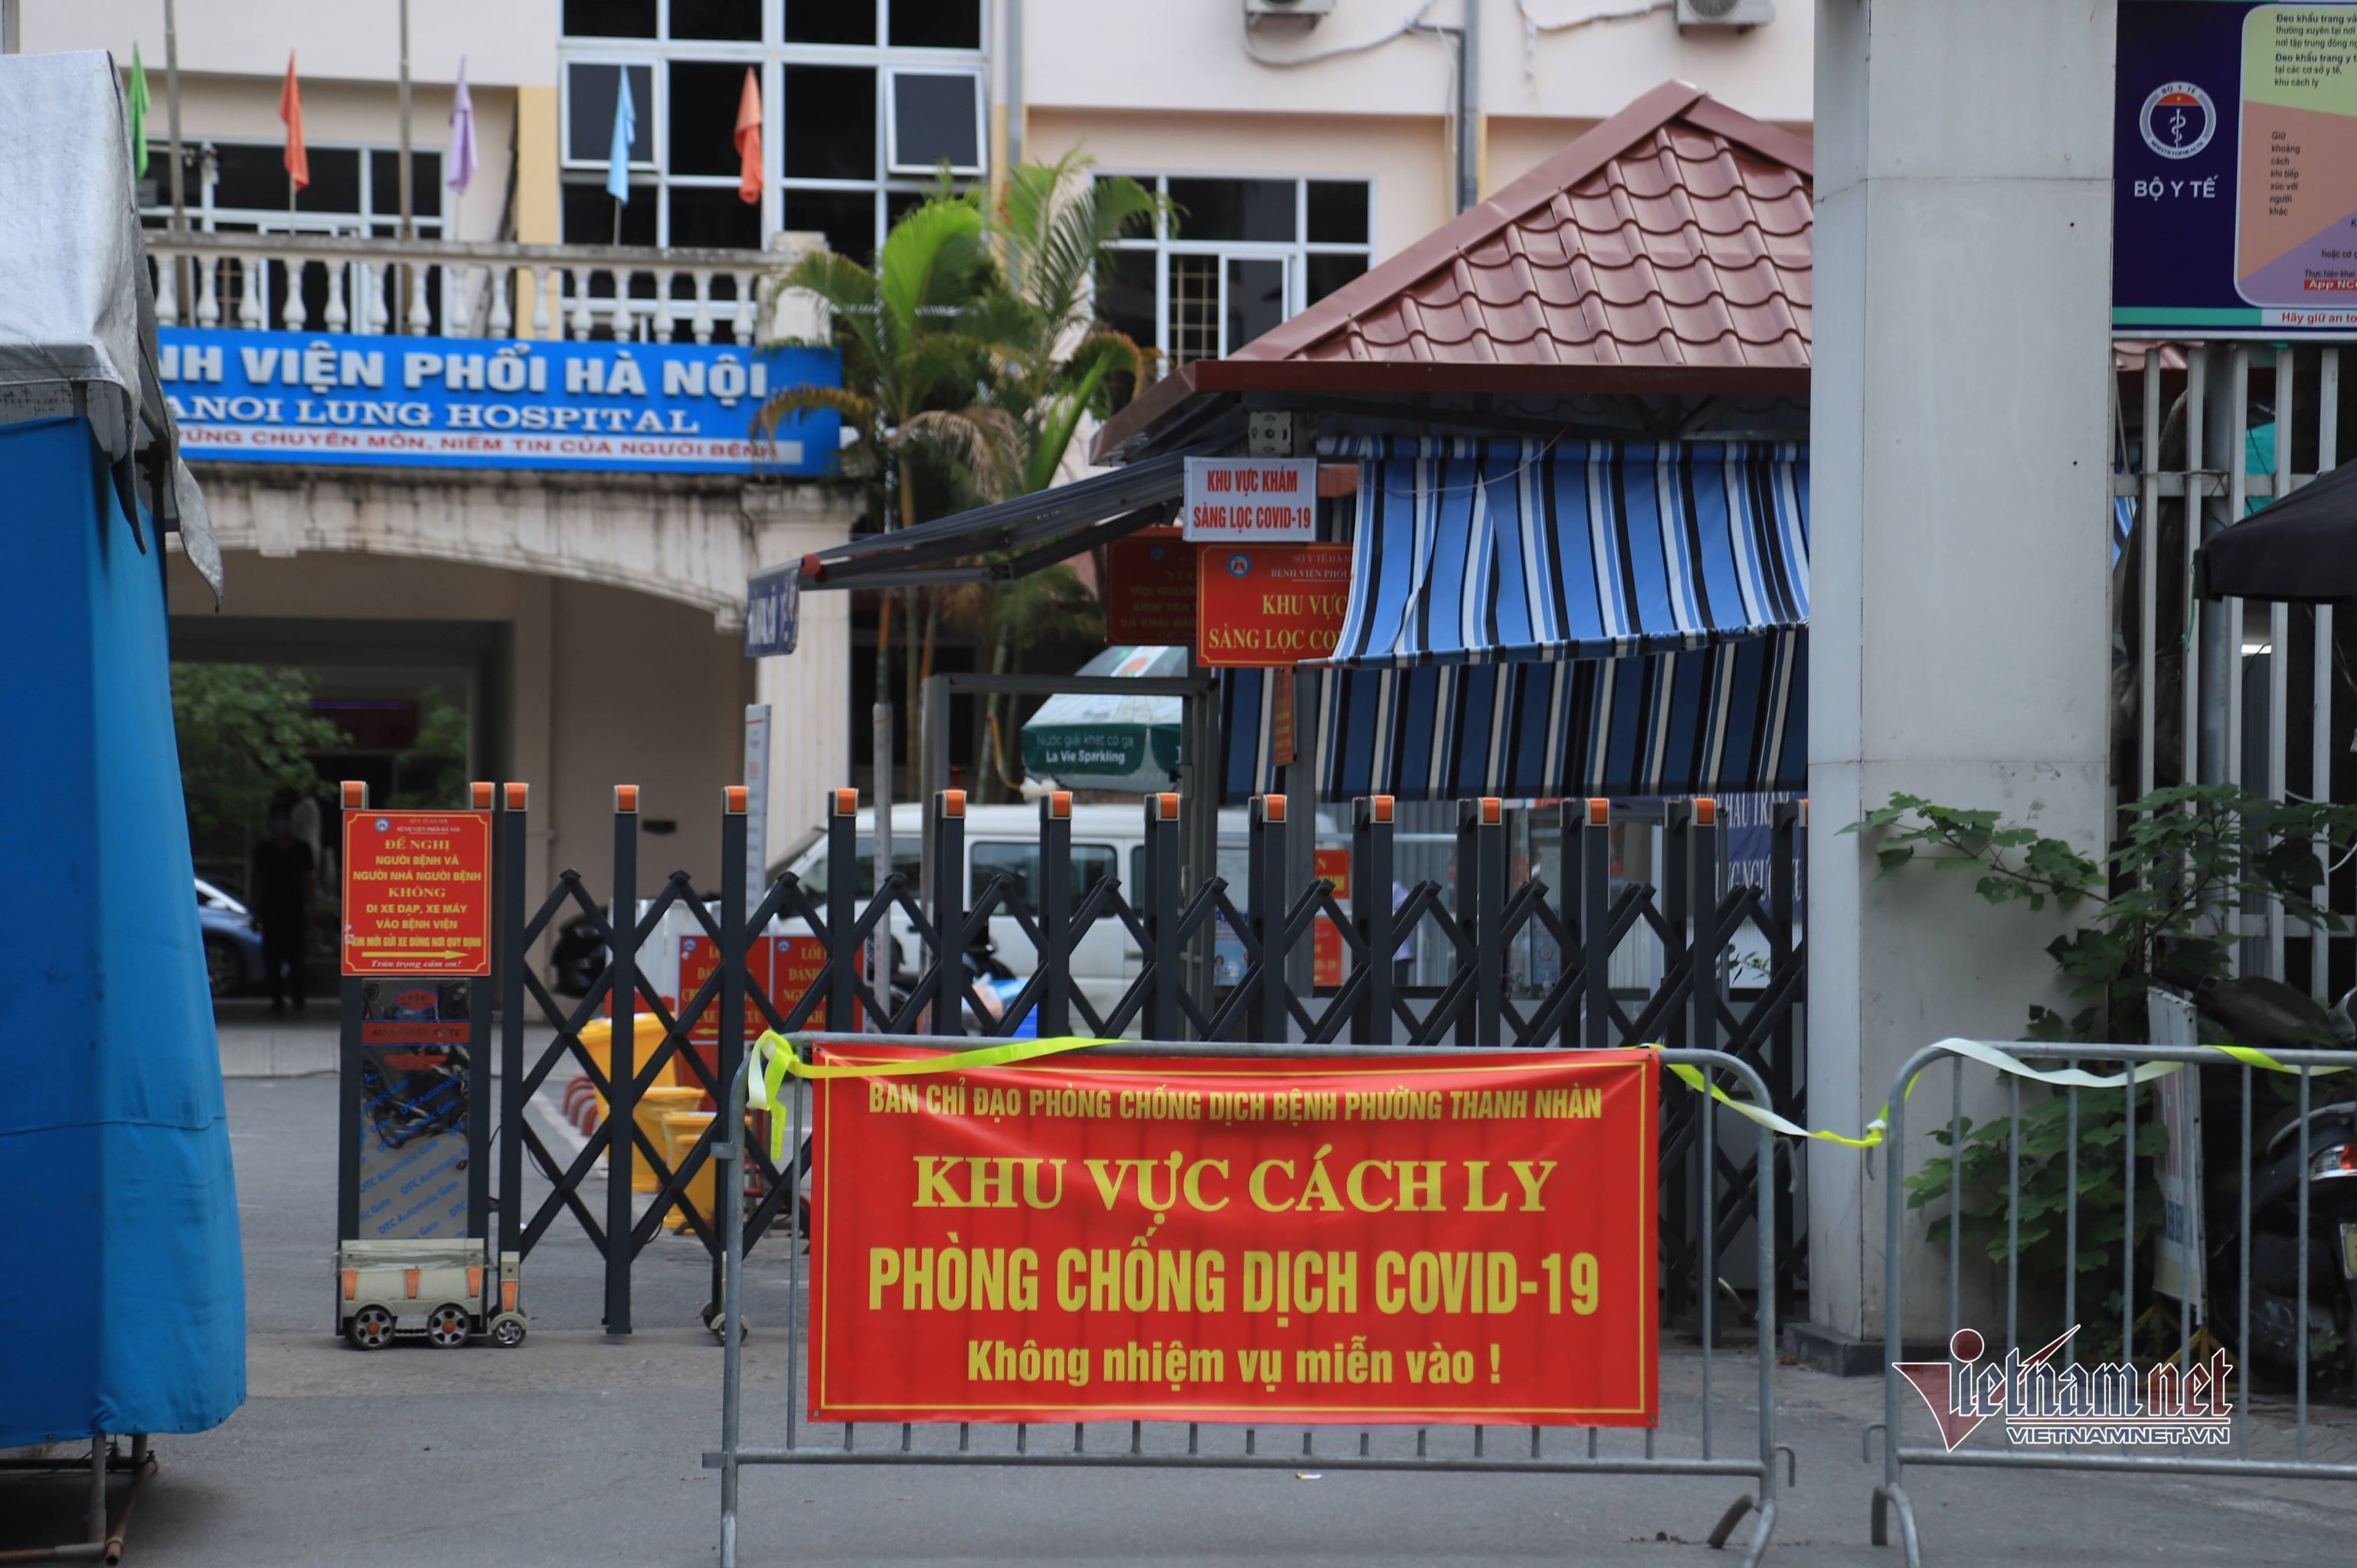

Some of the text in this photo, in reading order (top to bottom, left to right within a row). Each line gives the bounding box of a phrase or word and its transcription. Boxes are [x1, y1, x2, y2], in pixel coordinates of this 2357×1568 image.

[2321, 15, 2344, 25] trang
[2304, 39, 2325, 49] trung
[2319, 54, 2343, 65] trang
[2274, 77, 2290, 86] khu
[2134, 174, 2219, 202] BỘ Y TẾ
[2309, 280, 2333, 291] App
[2281, 312, 2303, 325] Hãy
[2307, 312, 2326, 325] giữ
[240, 340, 385, 394] VIỆN
[404, 341, 548, 394] PHỔI
[565, 349, 647, 397] HÀ
[663, 353, 767, 407] NỘI
[295, 399, 433, 427] LUNG
[445, 402, 699, 434] HOSPITAL
[252, 429, 360, 448] CHUYÊN
[512, 439, 552, 453] TIN
[1207, 466, 1298, 497] KHU VỰC KHÁM
[1193, 501, 1311, 533] SÀNG LỌC COVID-19
[1263, 593, 1348, 619] KHU VỰC
[1209, 623, 1260, 650] SÀNG
[1266, 629, 1304, 654] LỌC
[1046, 750, 1126, 765] La Vie Sparkling
[410, 840, 449, 852] NGHỊ
[414, 854, 441, 867] BỆNH
[444, 854, 459, 865] VÀ
[391, 869, 413, 880] NHÀ
[453, 871, 481, 884] BỆNH
[388, 886, 446, 897] KHÔNG
[381, 904, 394, 913] XE
[426, 905, 440, 913] XE
[443, 902, 467, 913] MÁY
[376, 918, 458, 931] VÀO BỆNH VIỆN
[868, 1076, 1602, 1126] BAN CHỈ ĐẠO PHÒNG CHỐNG DỊCH BỆNH PHƯỜNG THANH NHÀN
[912, 1143, 1558, 1225] KHU VỰC CÁCH LY
[868, 1227, 1600, 1328] PHÒNG CHỐNG DỊCH COVID-19
[968, 1340, 1090, 1387] Không
[1103, 1340, 1224, 1391] nhiệm
[1237, 1348, 1282, 1392] vụ
[1296, 1335, 1392, 1383] miễn
[1405, 1342, 1474, 1383] vào
